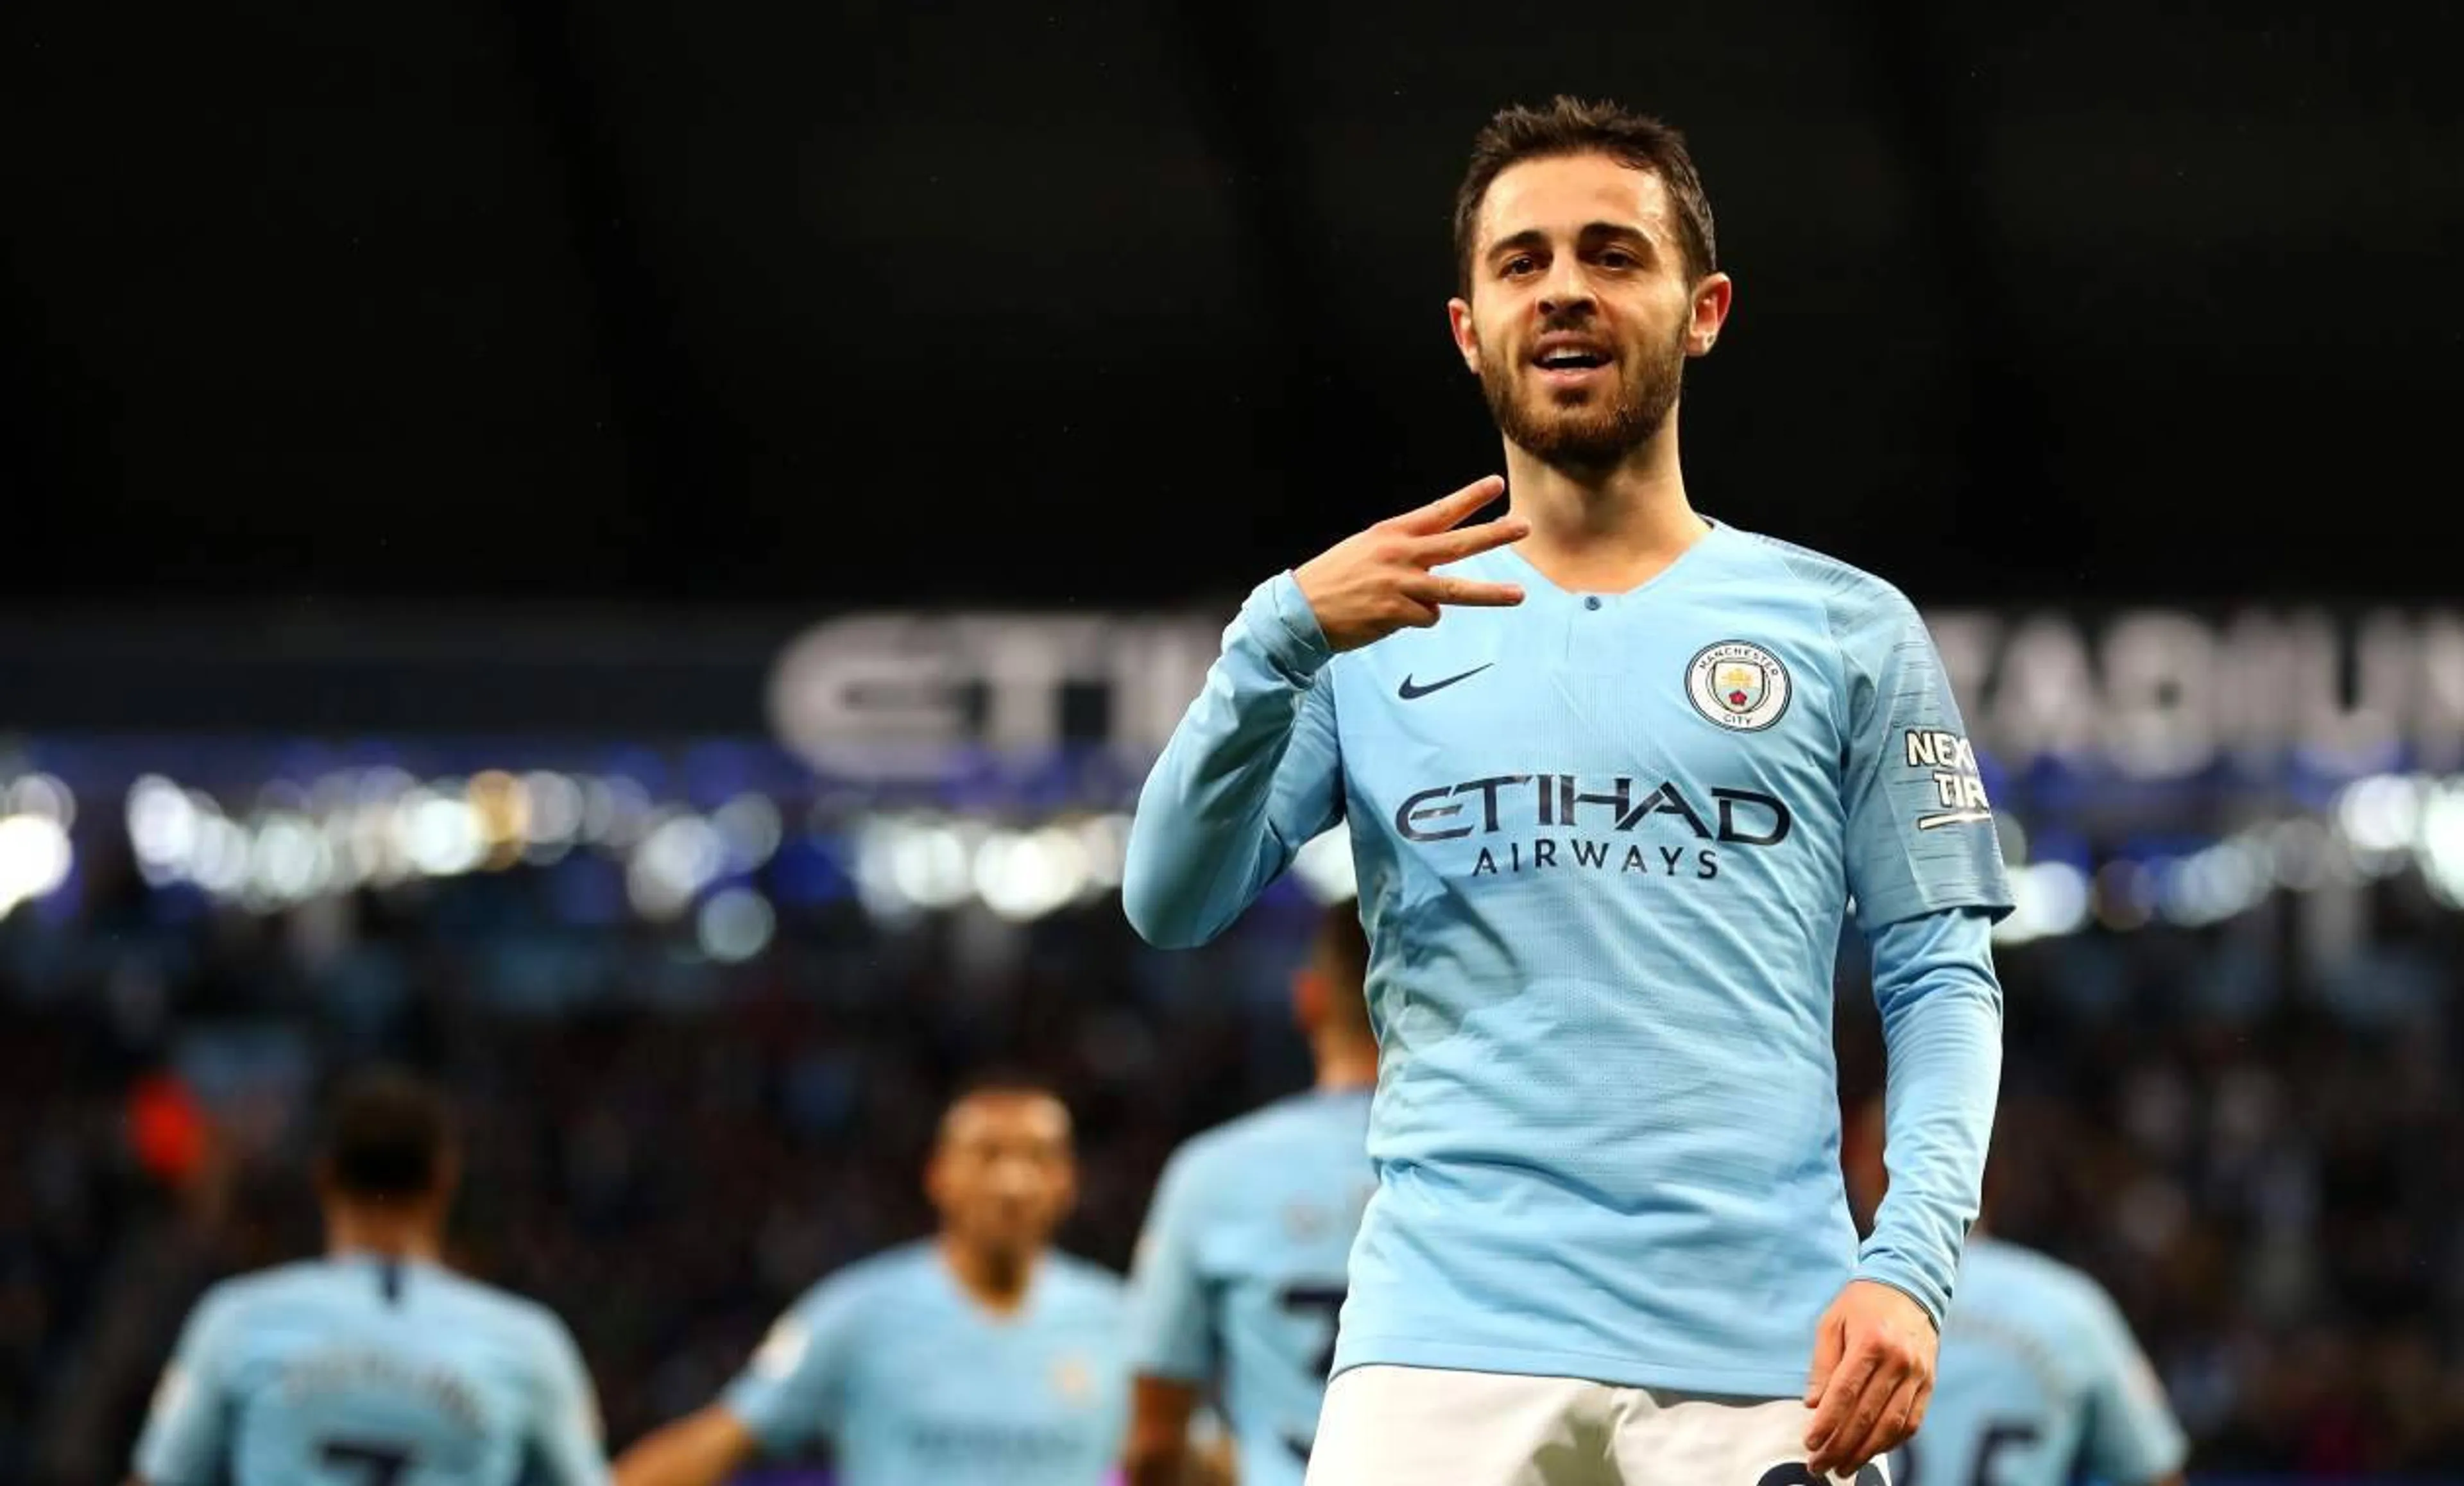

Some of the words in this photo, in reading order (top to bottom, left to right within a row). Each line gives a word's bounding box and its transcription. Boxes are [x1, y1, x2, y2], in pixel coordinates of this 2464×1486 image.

[1698, 647, 1779, 676] MANCHESTER
[767, 610, 1222, 778] ETI
[1724, 714, 1752, 726] CITY
[1395, 773, 1792, 846] ETIHAD
[1472, 839, 1718, 878] AIRWAYS
